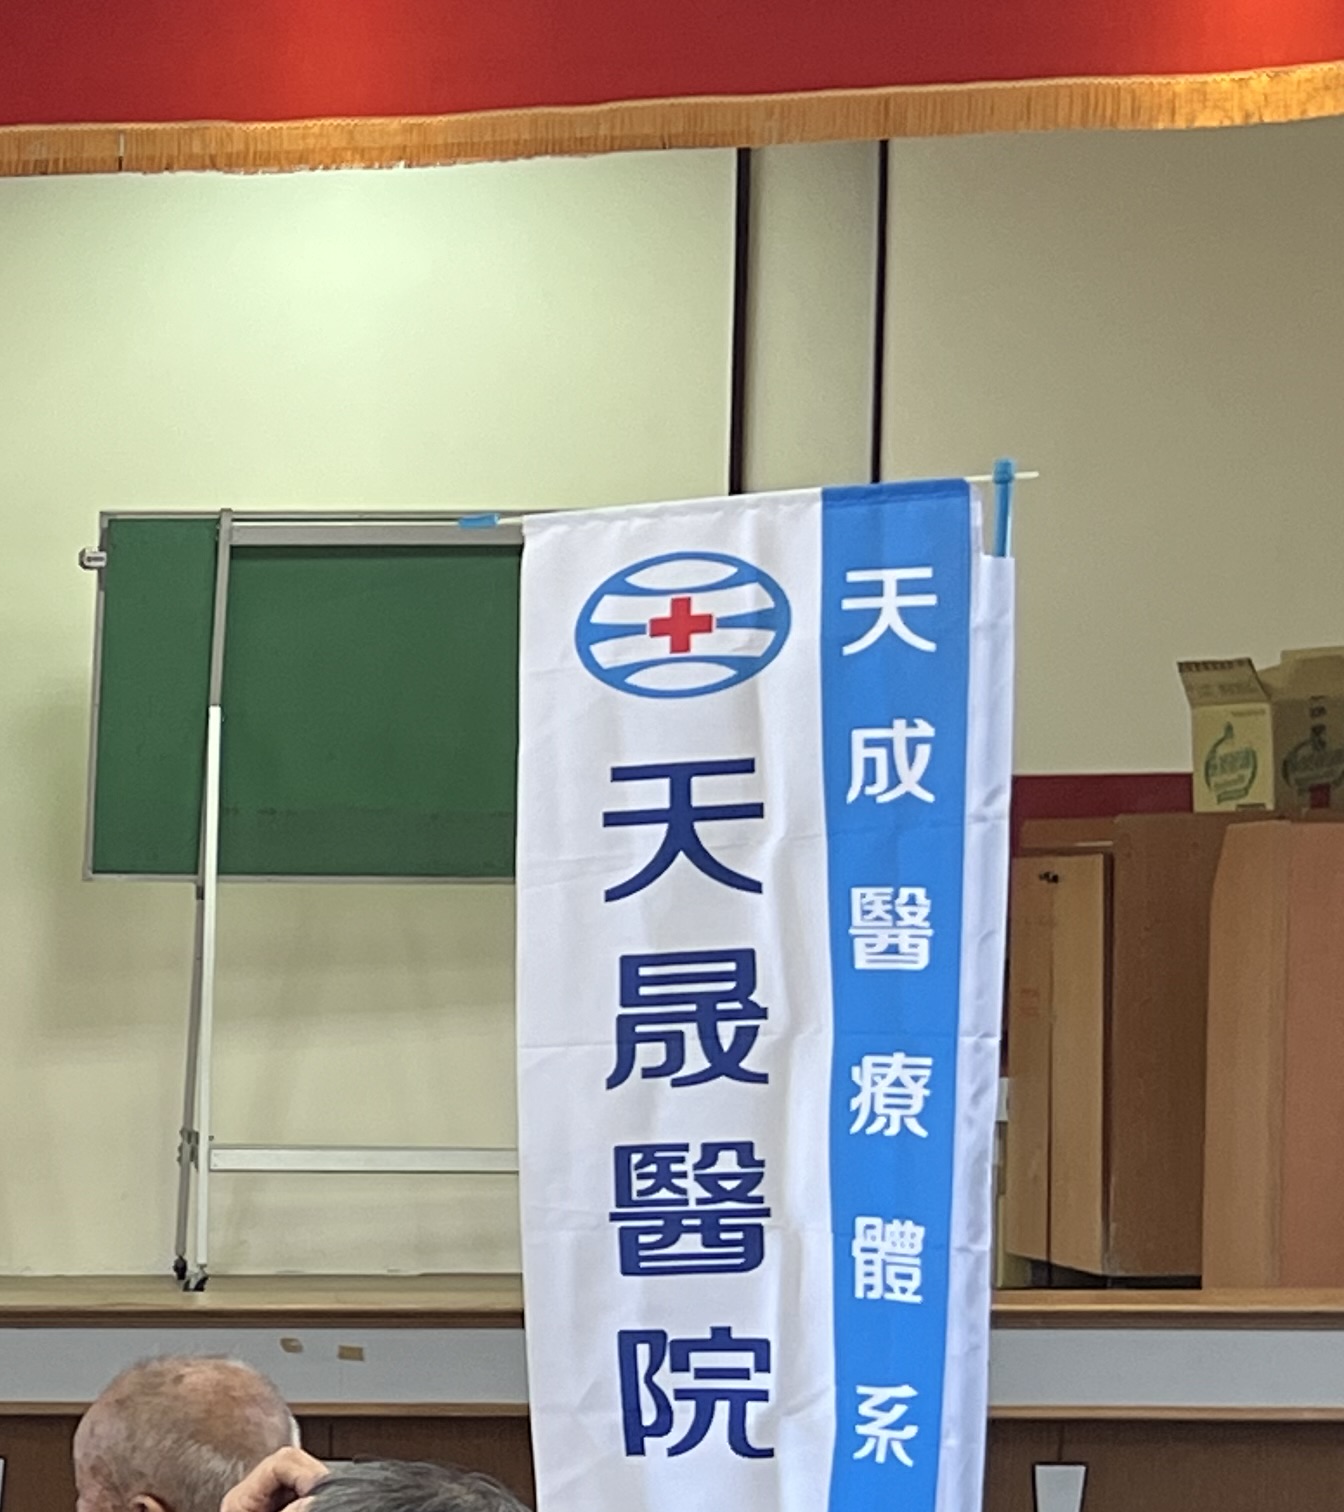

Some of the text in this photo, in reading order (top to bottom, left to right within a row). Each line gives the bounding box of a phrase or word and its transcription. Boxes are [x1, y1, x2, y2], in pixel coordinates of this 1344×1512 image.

[603, 757, 775, 1460] 天晟醫院
[841, 565, 938, 1468] 天成醫療體系
